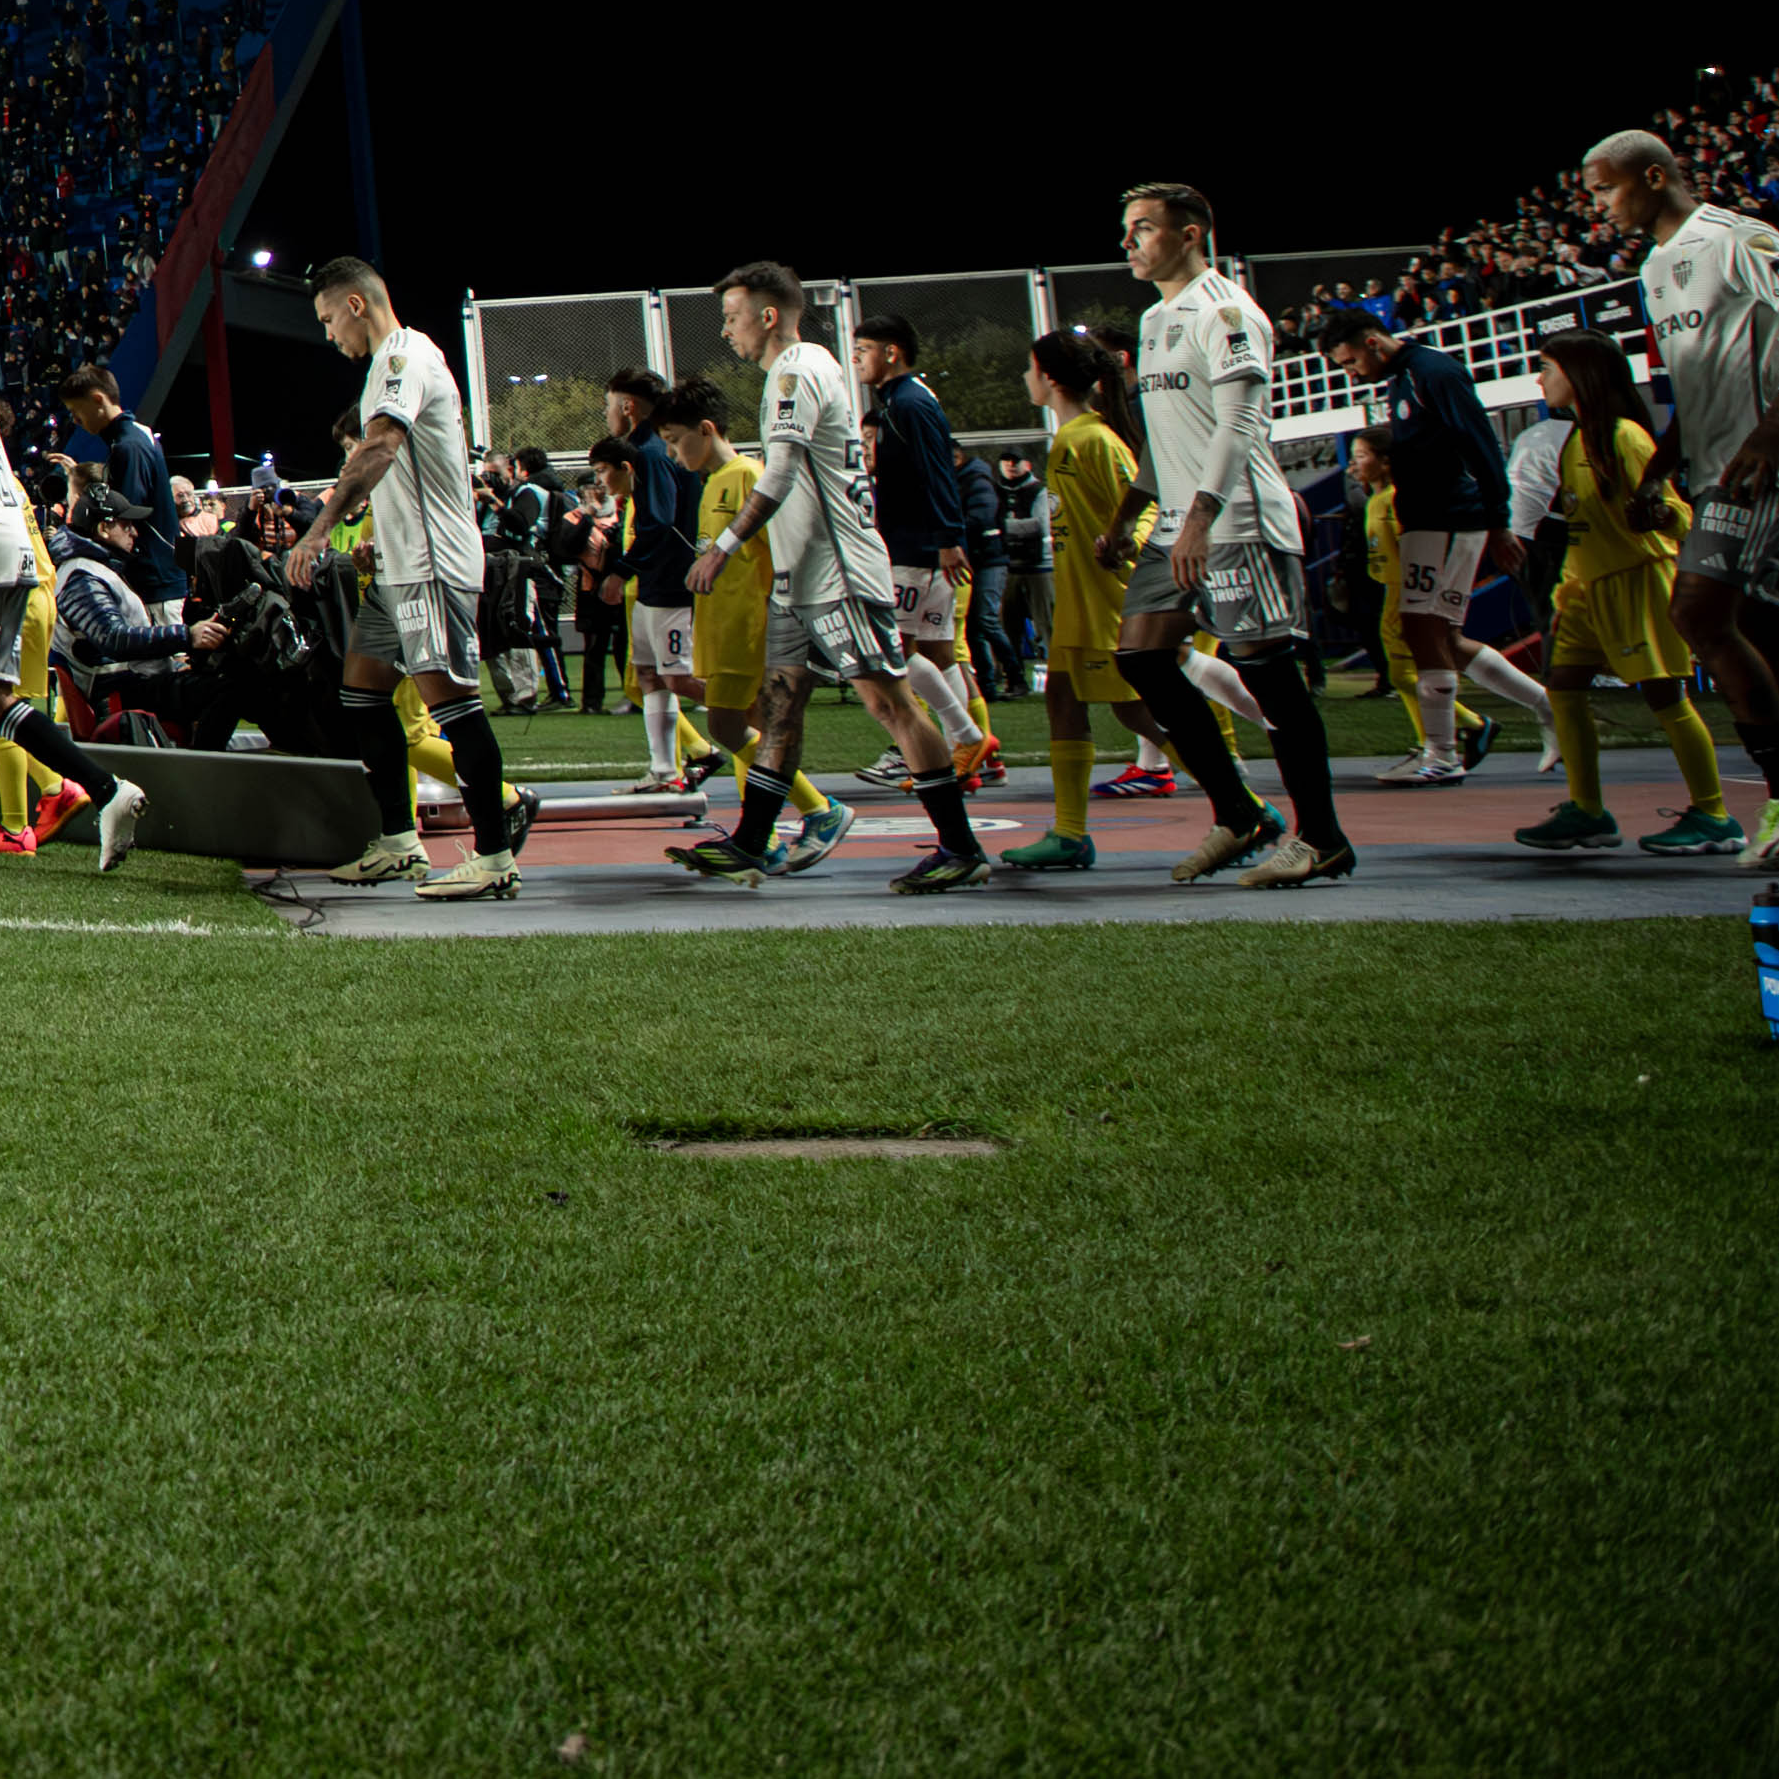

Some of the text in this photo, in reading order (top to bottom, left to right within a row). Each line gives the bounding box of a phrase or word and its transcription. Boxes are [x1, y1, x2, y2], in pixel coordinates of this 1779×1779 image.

[1140, 371, 1190, 392] ETANO
[1703, 501, 1752, 523] AUTO
[1699, 517, 1748, 539] TRUCK
[1204, 567, 1252, 590] AUTO
[1404, 562, 1436, 592] 35
[668, 628, 682, 655] 8
